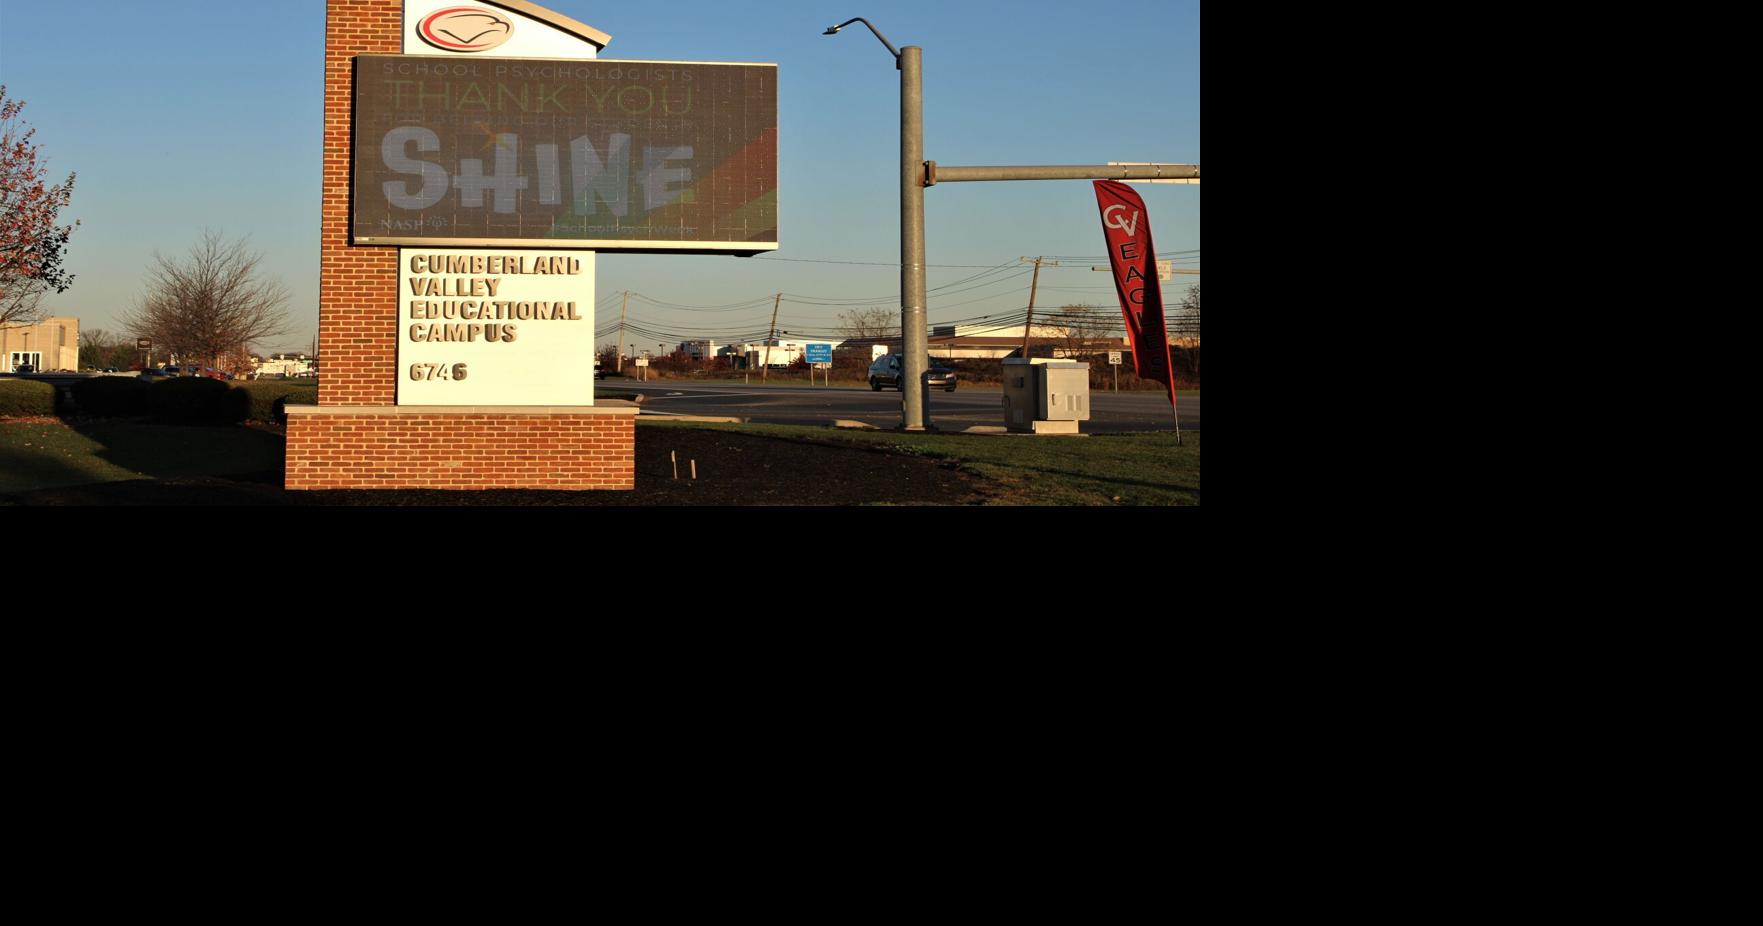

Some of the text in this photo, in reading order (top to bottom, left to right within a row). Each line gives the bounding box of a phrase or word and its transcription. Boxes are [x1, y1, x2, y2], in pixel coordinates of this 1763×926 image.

[383, 62, 693, 82] SCHOOL PSYCHOLOGISTS
[383, 79, 692, 115] THANK YOU
[381, 126, 694, 217] SHINE
[1103, 203, 1139, 237] CV
[410, 254, 583, 275] CUMBERLAND
[409, 277, 501, 297] VALLEY
[410, 300, 582, 321] EDUCATIONAL
[409, 323, 518, 342] CAMPUS
[409, 362, 468, 381] 6746
